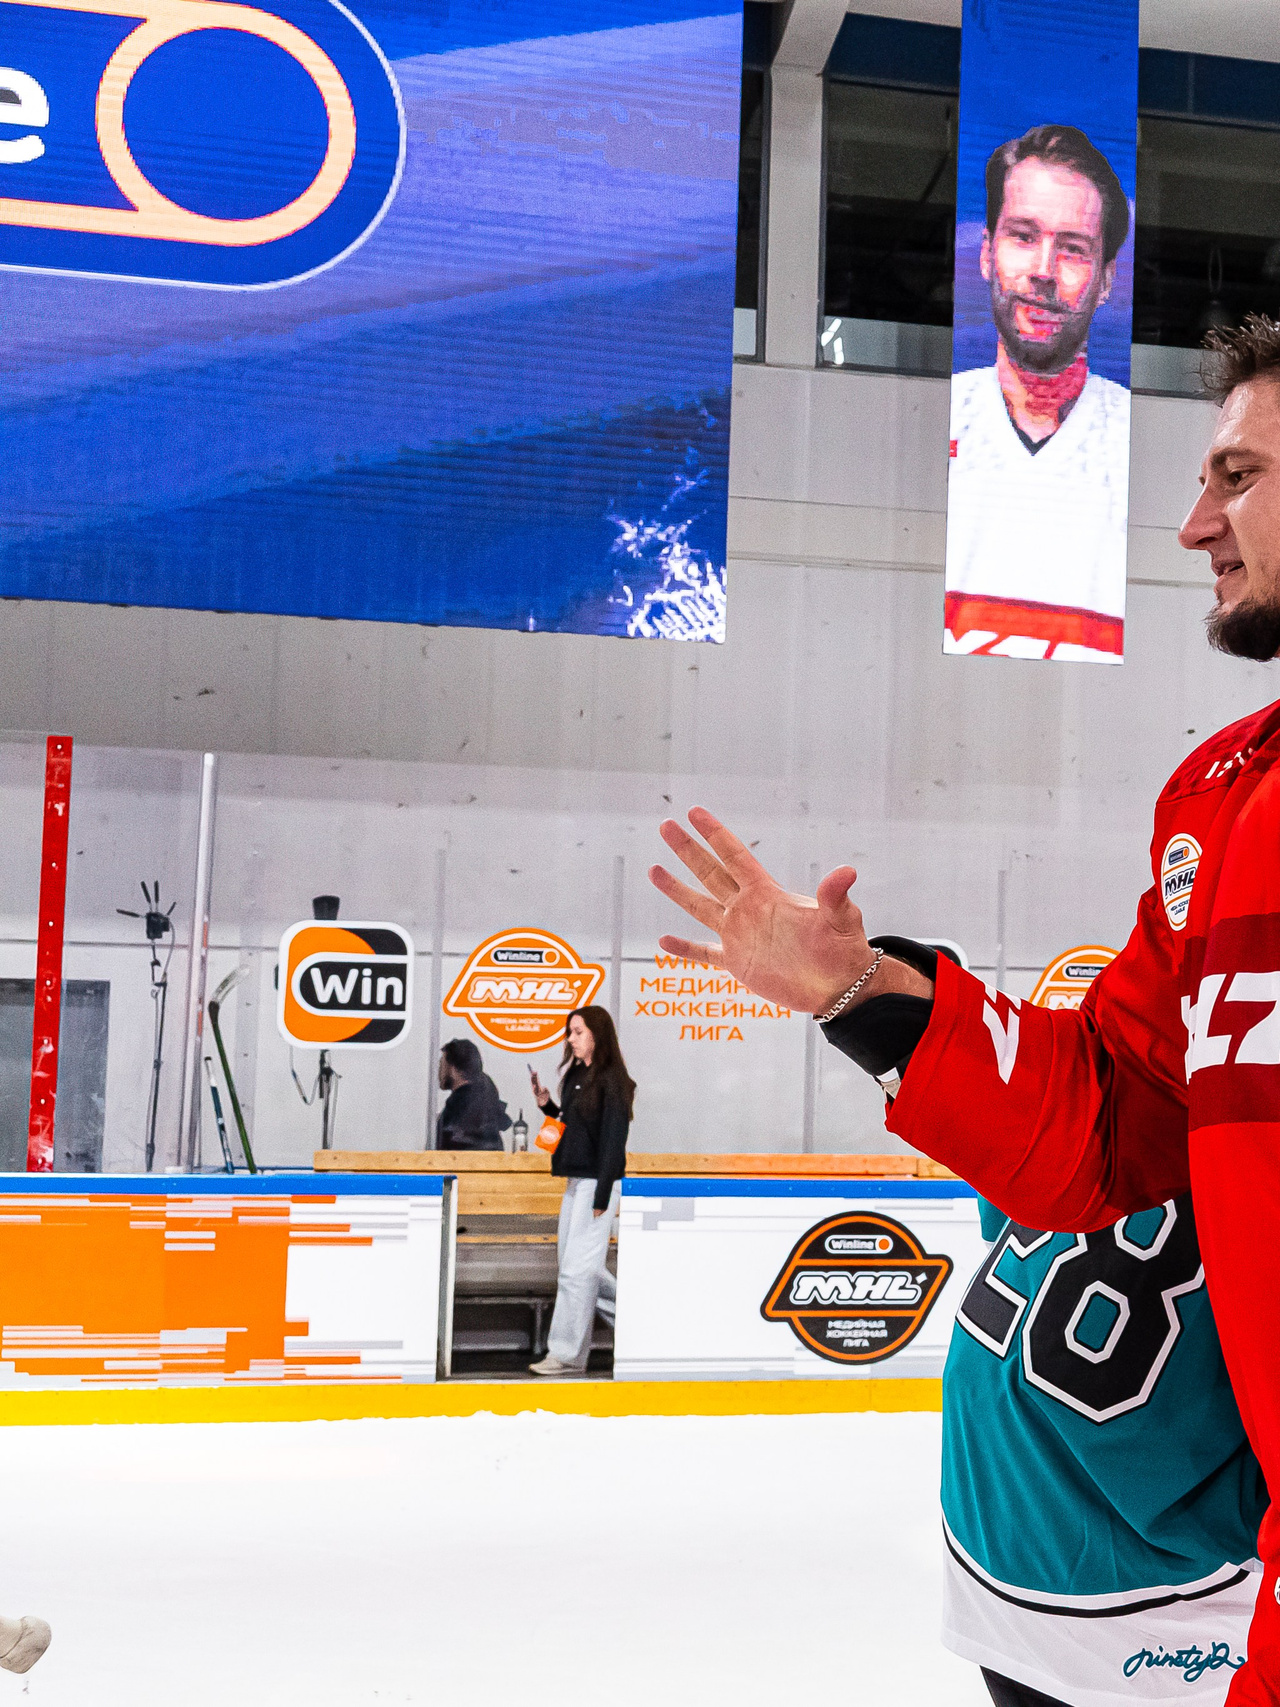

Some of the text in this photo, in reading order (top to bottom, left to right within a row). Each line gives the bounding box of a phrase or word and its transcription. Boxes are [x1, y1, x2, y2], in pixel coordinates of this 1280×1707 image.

[310, 967, 404, 1006] Win
[470, 978, 576, 1003] MHL
[640, 974, 758, 997] МЕДИЙН
[634, 998, 792, 1018] ХОККЕЙНАЯ
[679, 1024, 744, 1041] ЛИГА
[790, 1273, 920, 1303] MHL
